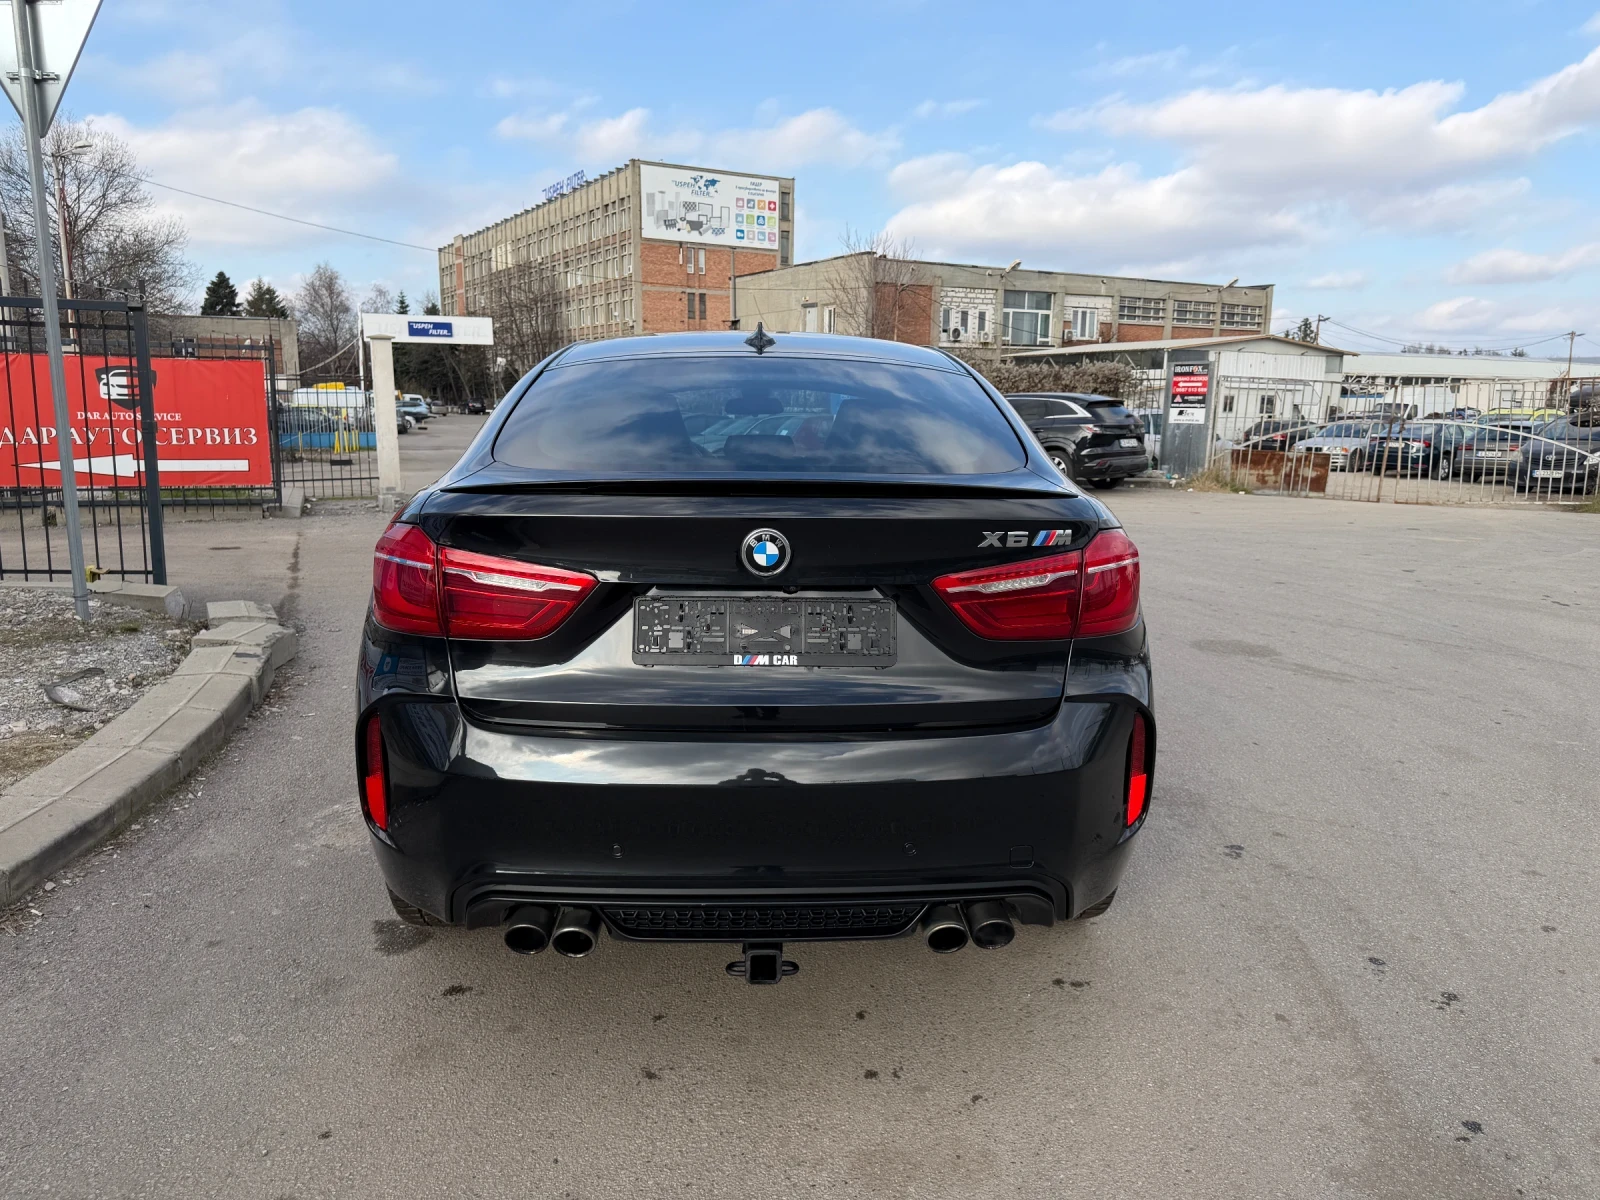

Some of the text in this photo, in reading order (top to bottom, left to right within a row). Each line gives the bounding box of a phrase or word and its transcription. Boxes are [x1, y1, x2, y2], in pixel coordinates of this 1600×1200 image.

[77, 412, 182, 421] DAR AUTO SVICE
[0, 426, 57, 448] ДАР
[750, 534, 784, 548] BMW
[977, 531, 1029, 547] X6
[773, 654, 798, 666] CAR
